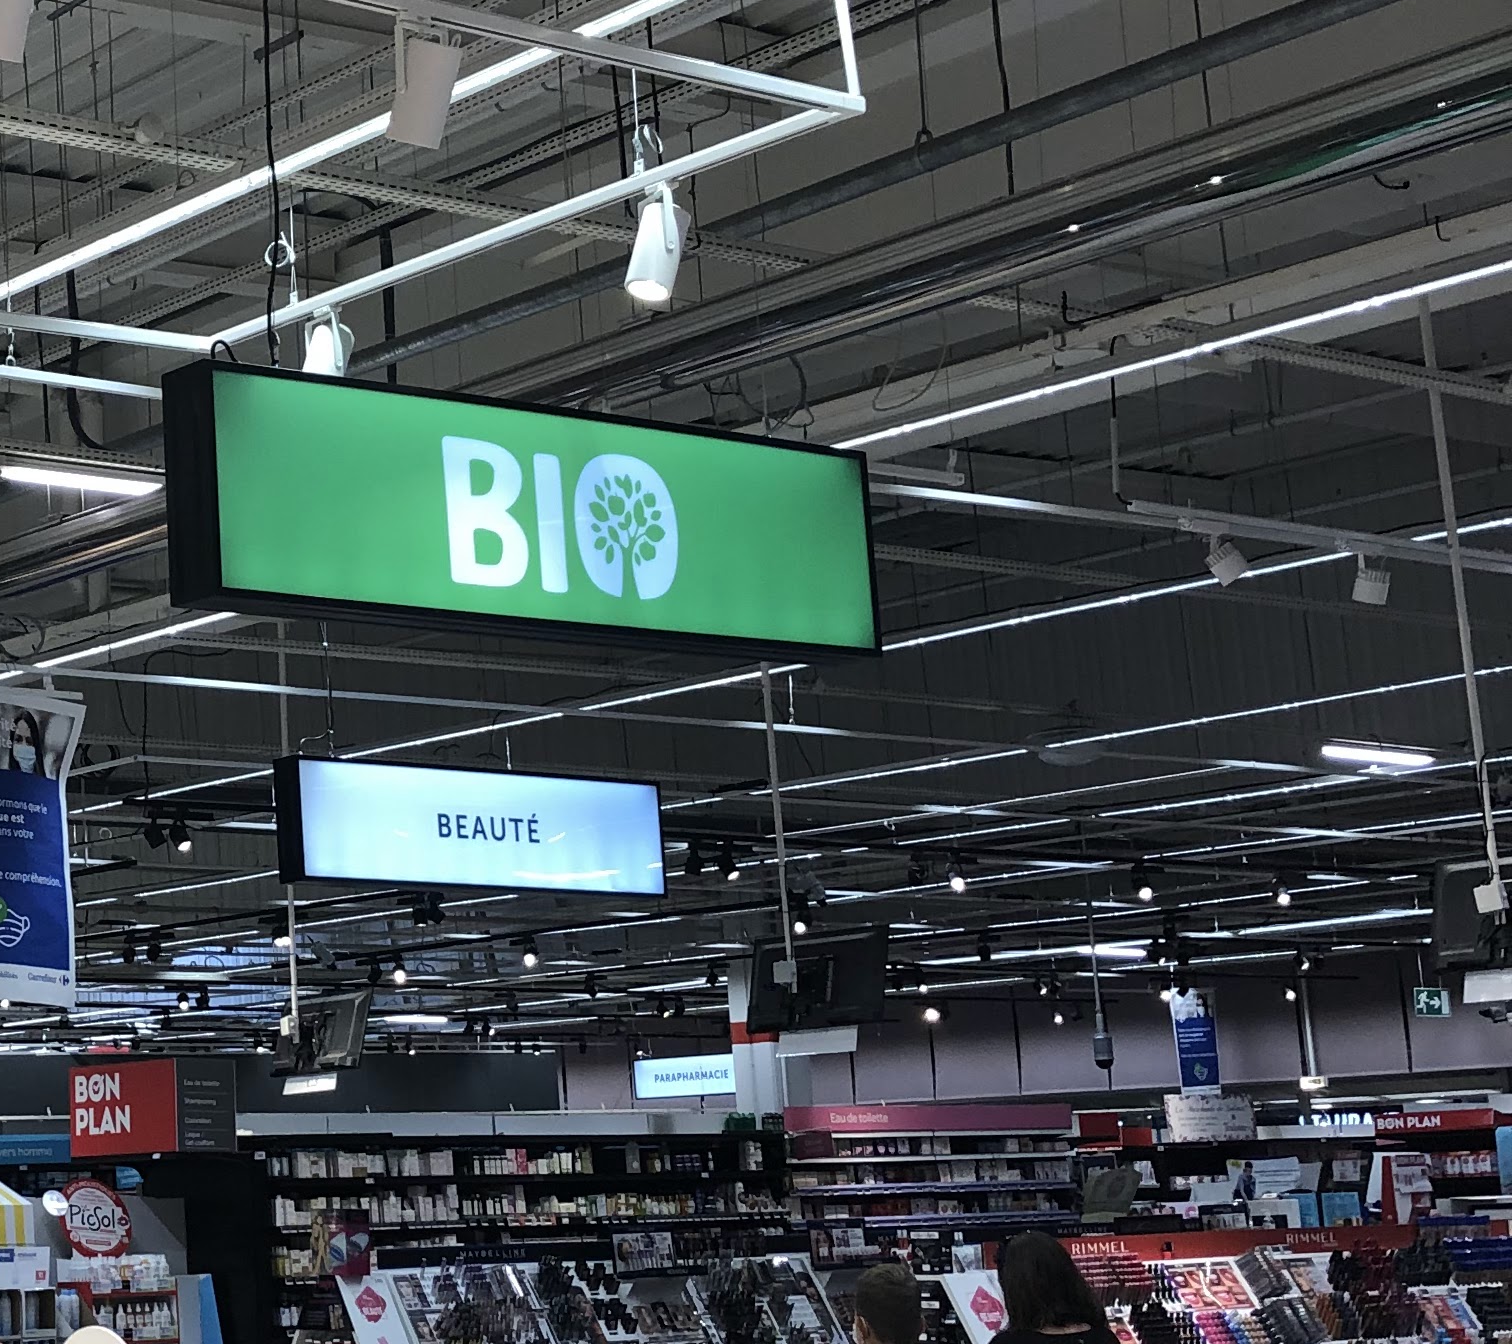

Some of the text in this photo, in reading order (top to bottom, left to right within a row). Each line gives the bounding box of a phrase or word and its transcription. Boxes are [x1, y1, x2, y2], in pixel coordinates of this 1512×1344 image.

[441, 436, 679, 600] BIO
[11, 813, 25, 824] est
[13, 829, 34, 839] votre
[437, 812, 541, 844] BEAUTÉ
[654, 1068, 729, 1084] PARAPHARMACIE
[75, 1072, 120, 1103] BON
[75, 1105, 131, 1136] PLAN
[830, 1112, 889, 1124] Eau de toilette
[1376, 1115, 1441, 1130] BON PLAN
[17, 1146, 53, 1157] homme
[1285, 1231, 1337, 1244] RIMMEL
[1071, 1240, 1130, 1255] RIMMEL
